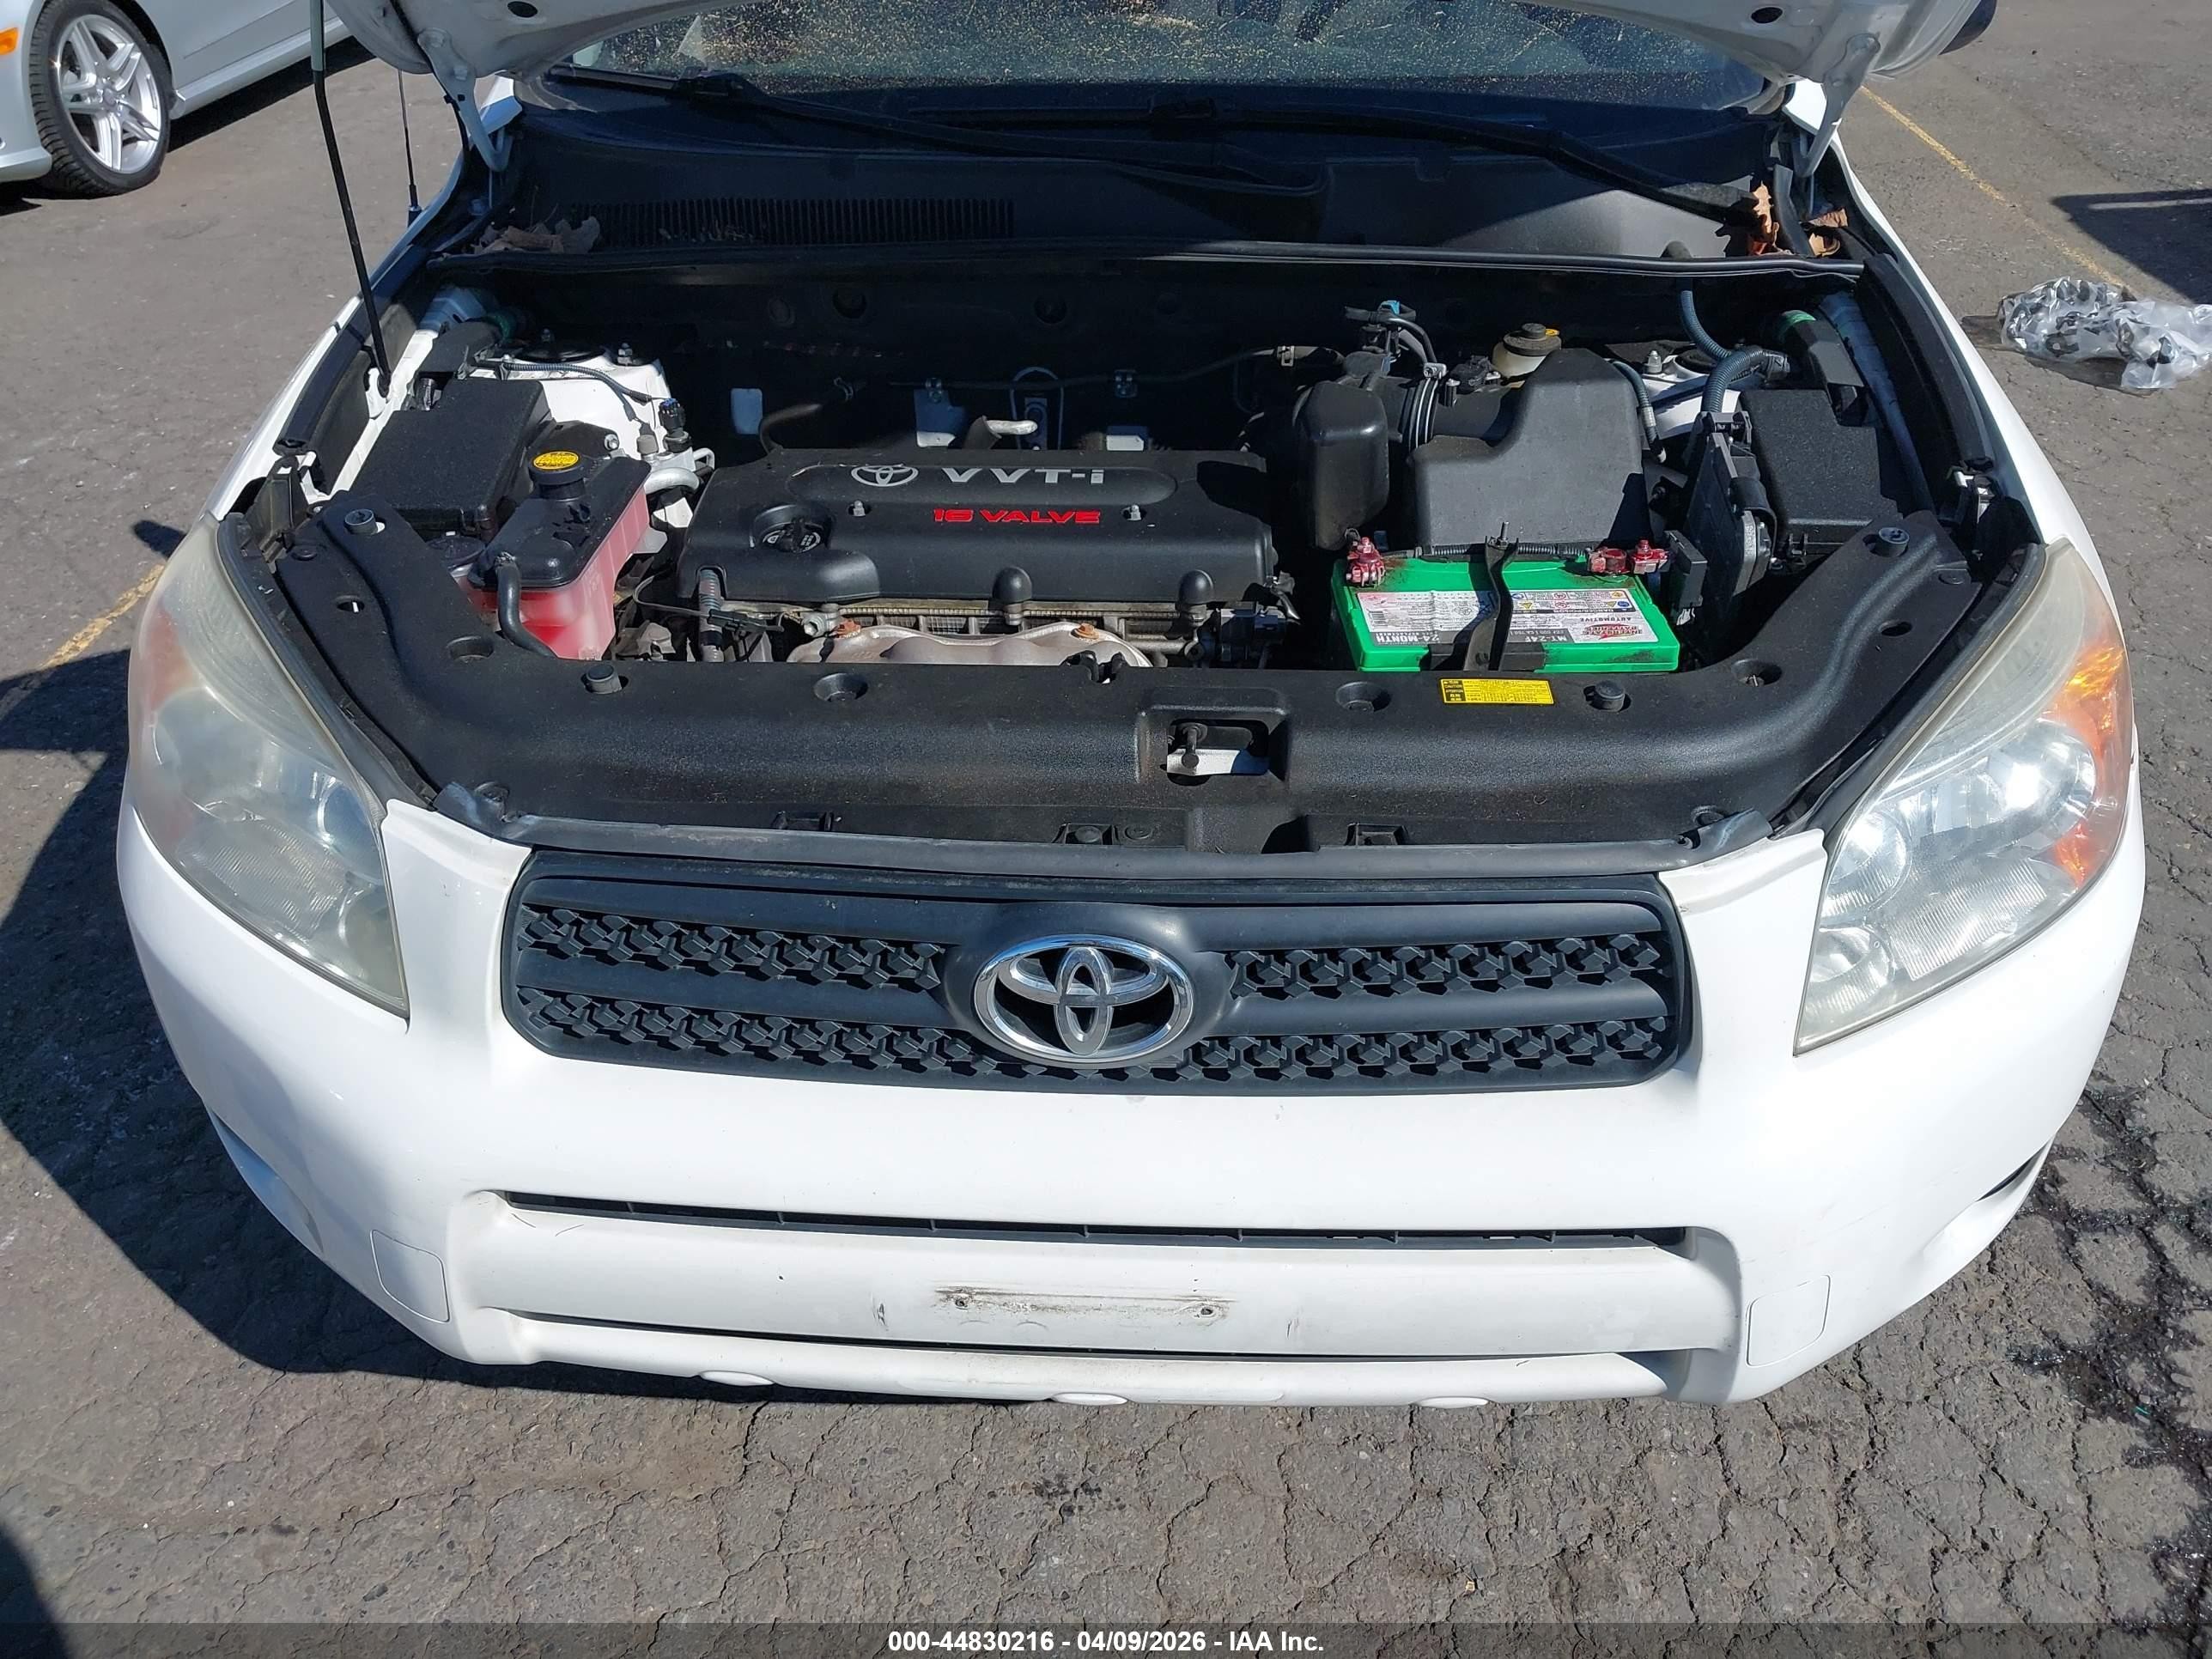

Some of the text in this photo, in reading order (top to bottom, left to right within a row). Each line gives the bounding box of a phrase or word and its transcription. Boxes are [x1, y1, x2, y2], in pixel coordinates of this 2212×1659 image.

[941, 467, 1104, 483] VVT-i
[933, 509, 1101, 523] 16 VALVE
[1376, 635, 1440, 643] 24-MONTH
